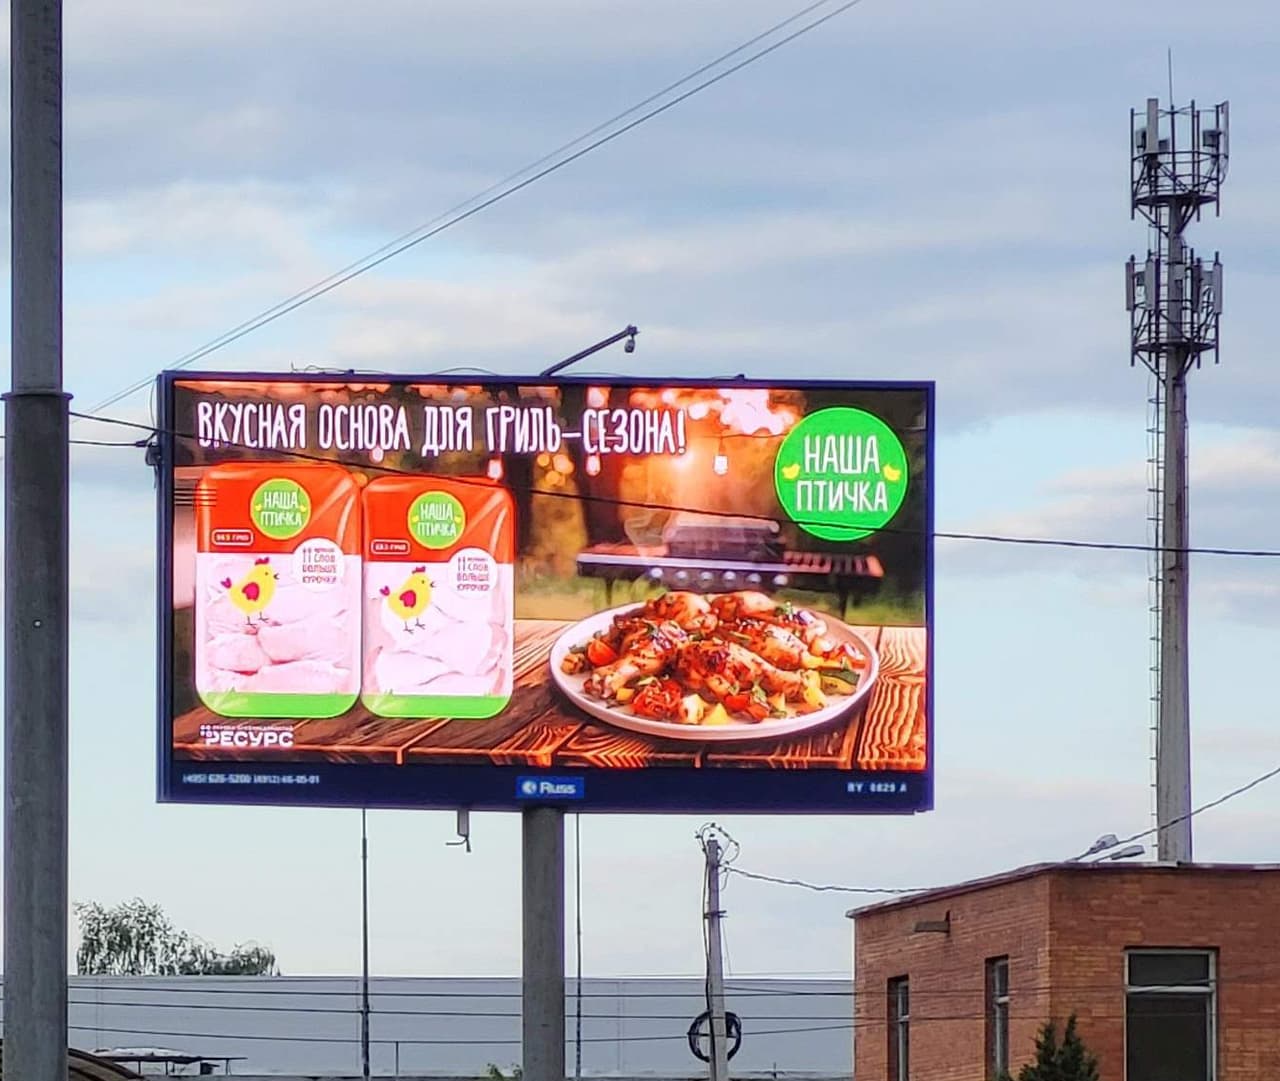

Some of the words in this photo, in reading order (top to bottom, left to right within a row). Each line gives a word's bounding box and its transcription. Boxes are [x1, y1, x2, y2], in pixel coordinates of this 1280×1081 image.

[198, 401, 306, 449] ВКУСНАЯ
[318, 403, 411, 451] ОСНОВА
[421, 405, 473, 457] ДЛЯ
[803, 434, 881, 475] НАША
[263, 491, 299, 509] НАША
[796, 480, 889, 513] ПТИЧКА
[260, 511, 303, 527] ПТИЧКА
[419, 503, 454, 521] НАША
[417, 522, 457, 538] ПТИЧКА
[204, 731, 294, 748] РЕСУРС
